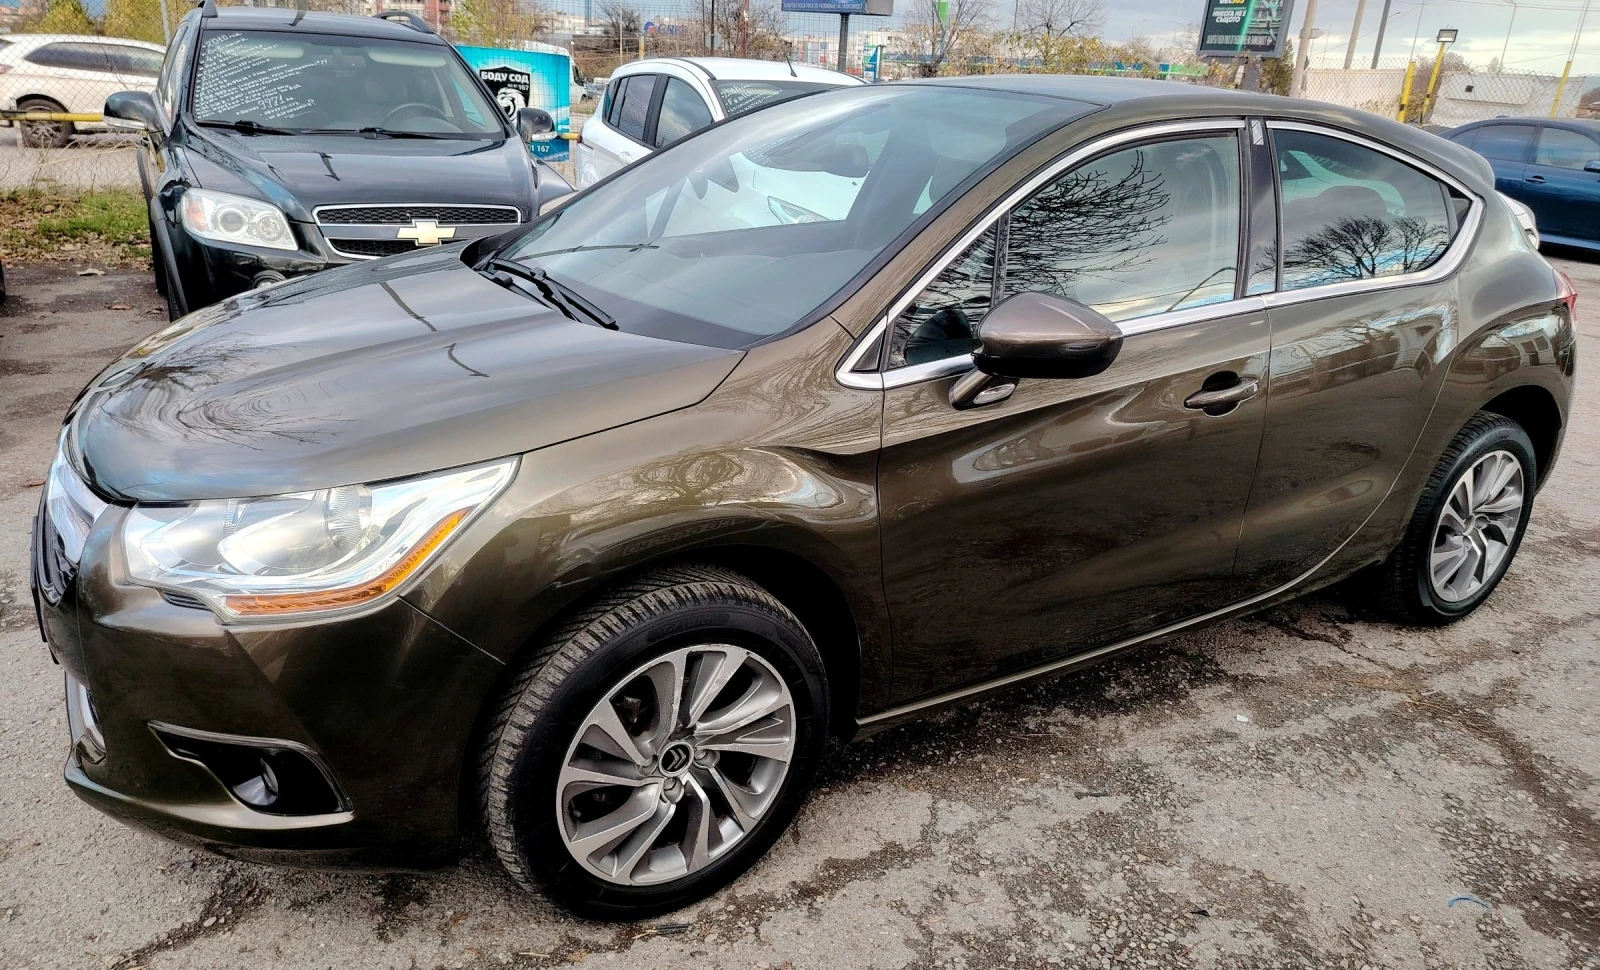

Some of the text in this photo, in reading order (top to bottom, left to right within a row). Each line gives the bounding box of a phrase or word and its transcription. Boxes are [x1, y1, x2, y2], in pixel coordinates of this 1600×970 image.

[1215, 16, 1241, 24] СЪЩОТО
[480, 71, 529, 84] БОДУ СОД
[537, 145, 550, 153] 167
